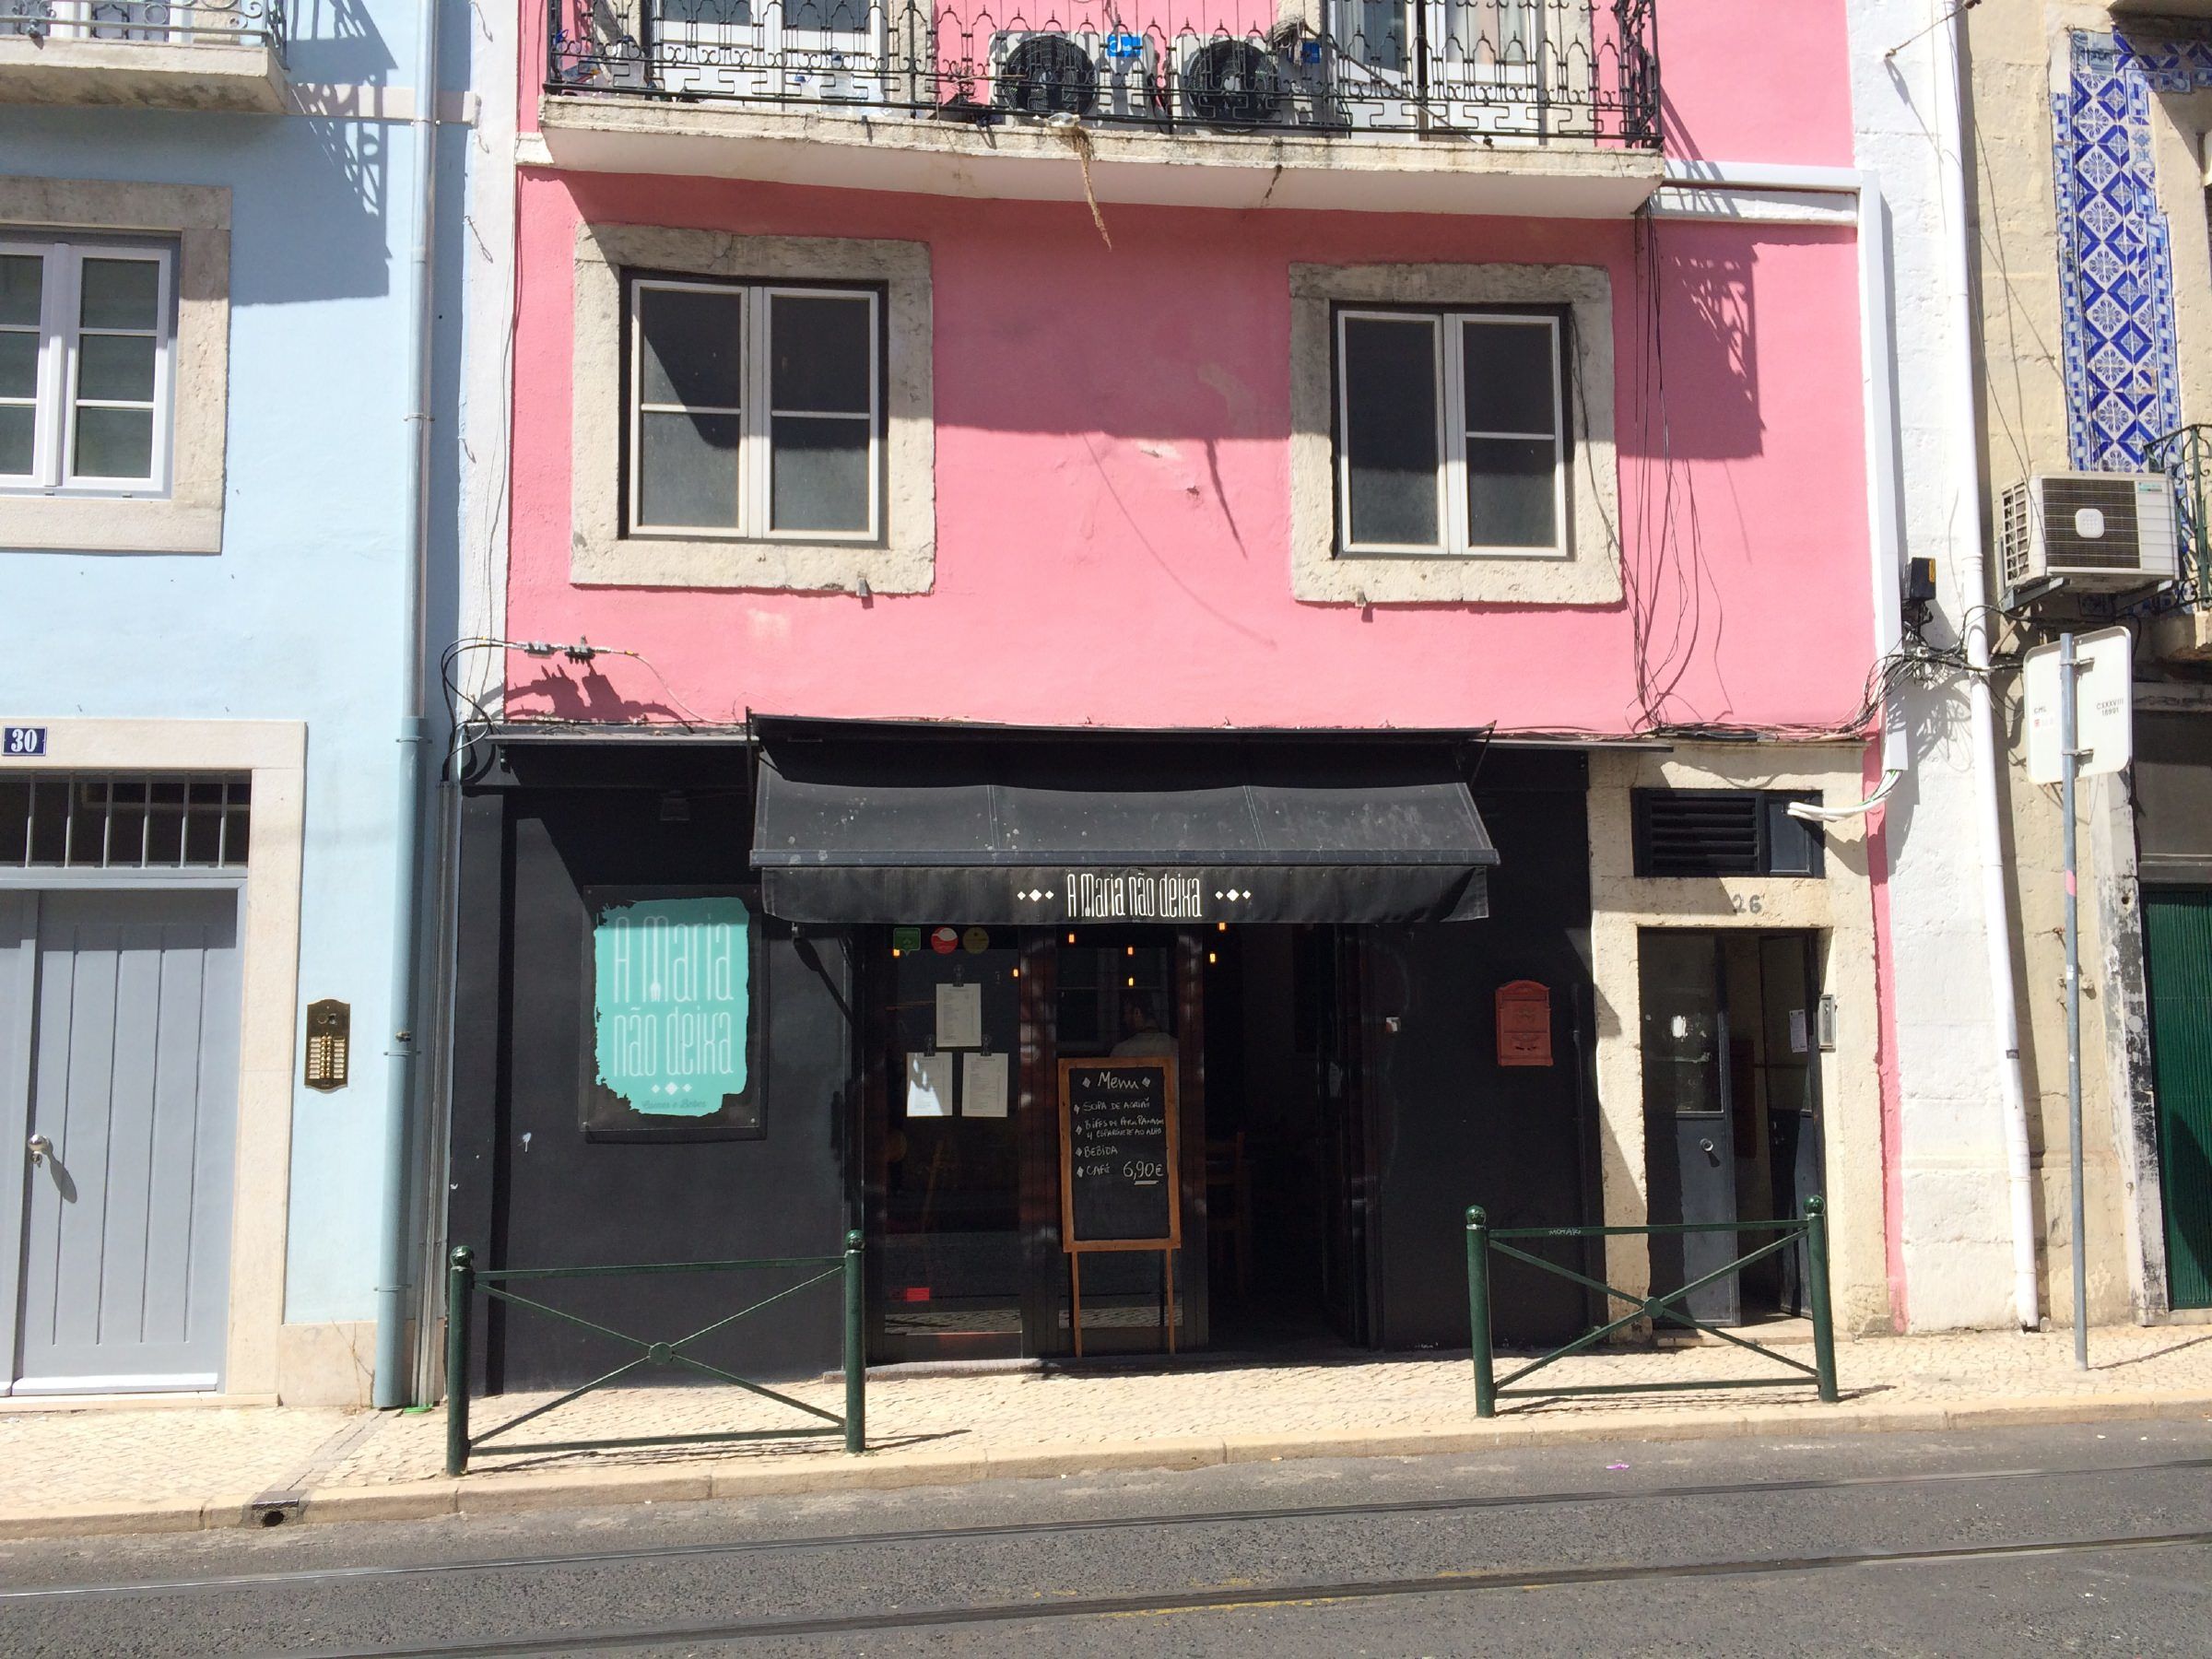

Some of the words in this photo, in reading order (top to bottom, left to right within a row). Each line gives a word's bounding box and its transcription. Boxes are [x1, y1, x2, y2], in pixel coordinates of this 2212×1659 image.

[10, 728, 38, 752] 30
[1067, 874, 1077, 918] A
[1080, 874, 1125, 918] Maria
[1128, 872, 1155, 917] não
[1159, 873, 1203, 918] deixa
[1732, 893, 1762, 914] 26
[613, 915, 630, 1004] A
[642, 912, 735, 1004] Maria
[613, 1006, 657, 1077] não
[665, 1005, 735, 1077] deixa
[1097, 1071, 1139, 1089] Menu
[1082, 1100, 1107, 1112] SOPA
[1111, 1101, 1121, 1110] DE
[1123, 1160, 1164, 1180] 6,90€
